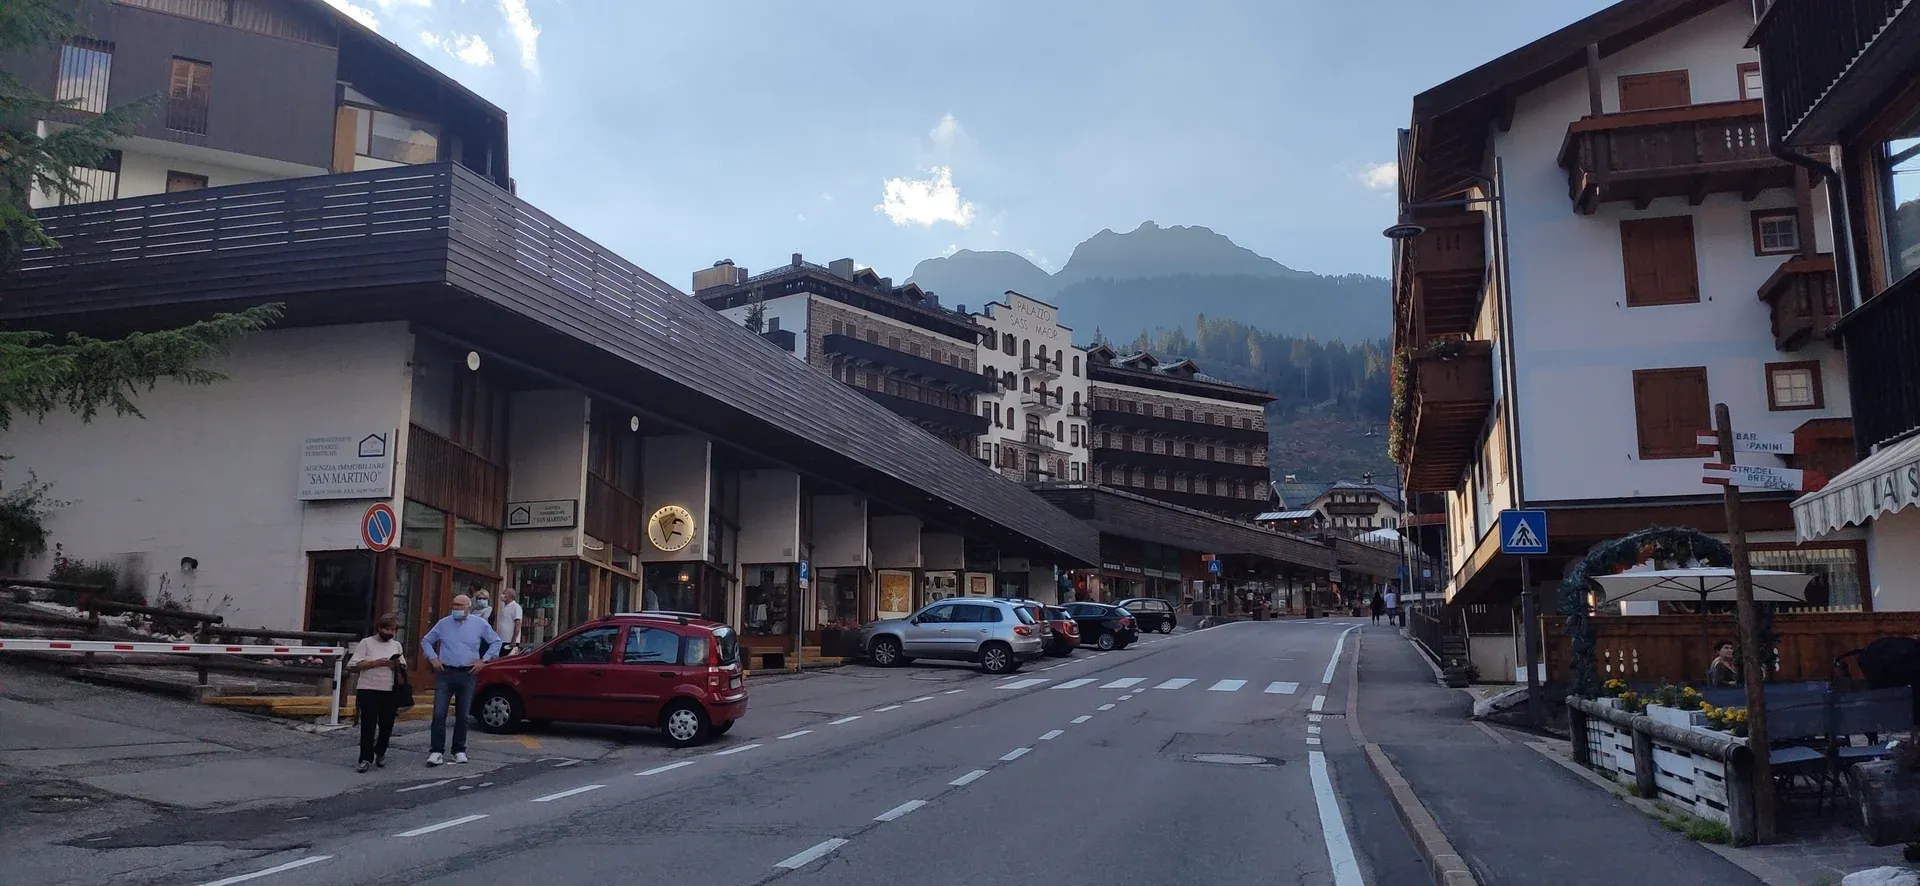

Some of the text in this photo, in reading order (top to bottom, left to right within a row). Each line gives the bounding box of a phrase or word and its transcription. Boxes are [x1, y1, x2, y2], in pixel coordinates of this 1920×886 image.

[1017, 300, 1051, 321] PALAZZO
[1010, 314, 1057, 339] SASS MAOR
[1736, 432, 1757, 441] BAR
[1731, 465, 1774, 475] STRUDEL
[1747, 474, 1785, 483] BREZEL
[1764, 481, 1794, 491] SPECK
[1873, 476, 1898, 510] LA
[801, 561, 807, 577] P
